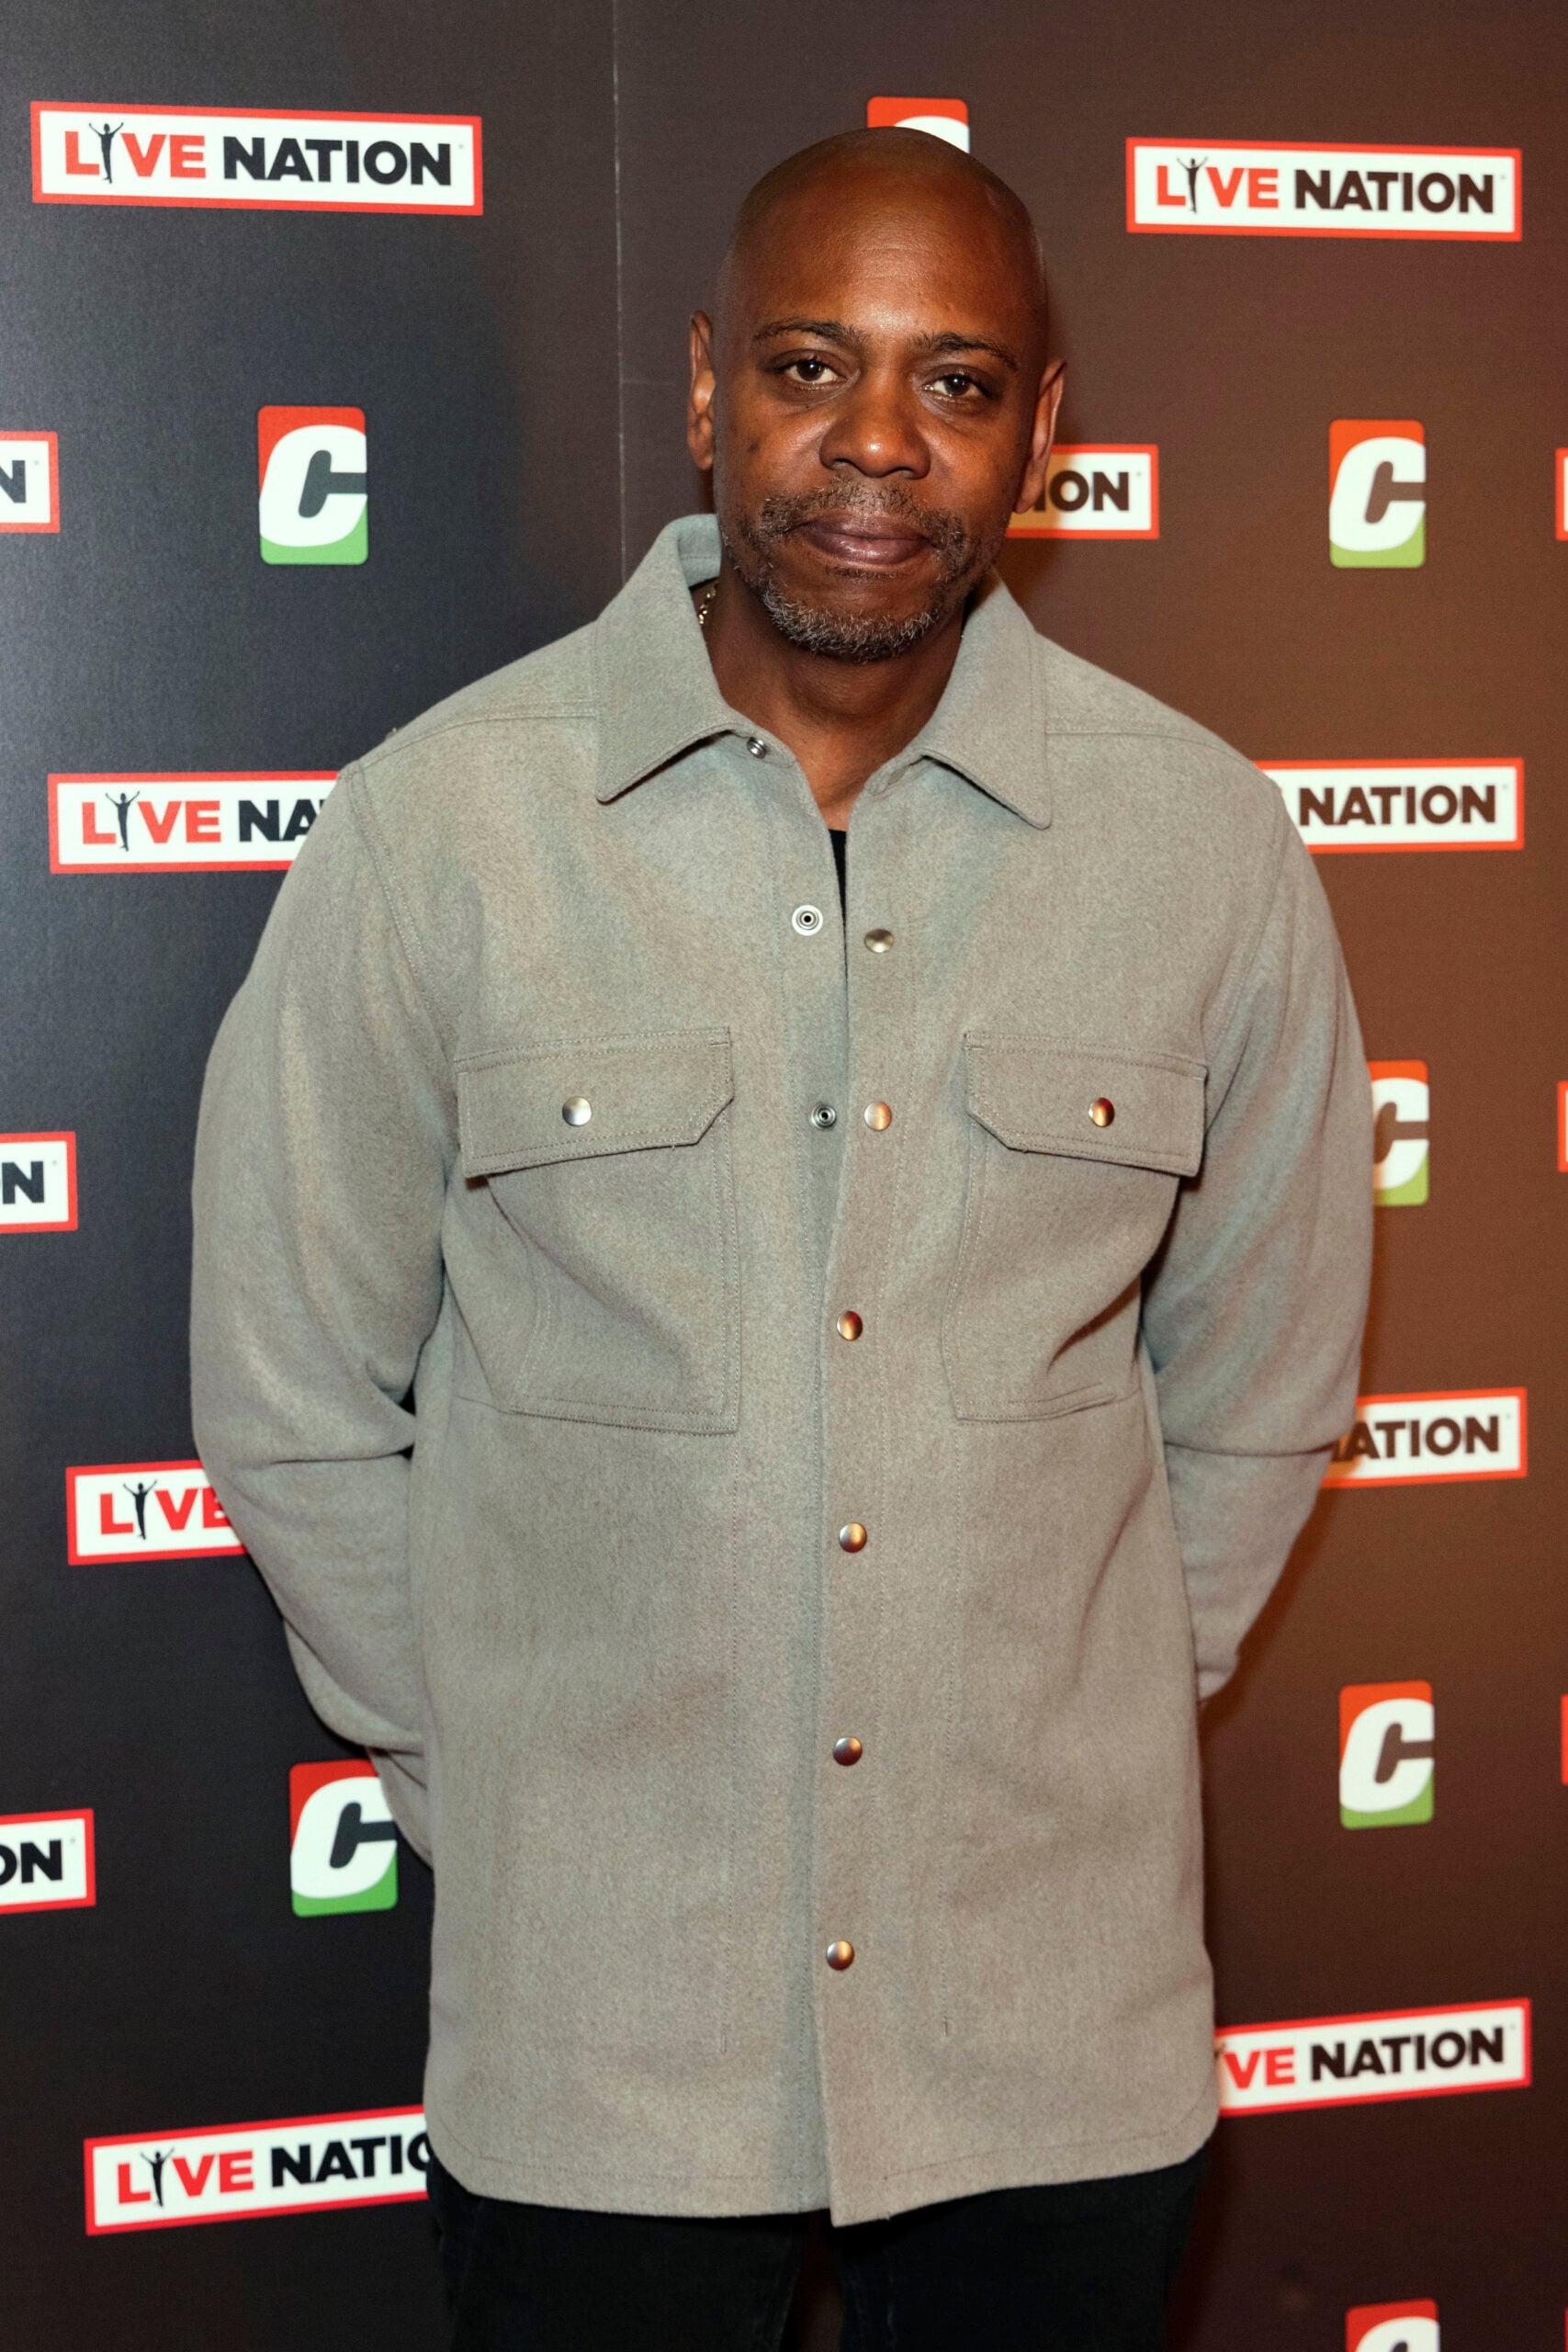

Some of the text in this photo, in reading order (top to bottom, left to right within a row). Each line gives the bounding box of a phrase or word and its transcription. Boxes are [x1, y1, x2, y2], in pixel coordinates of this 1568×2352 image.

[64, 121, 452, 186] LIVE NATION
[1156, 157, 1495, 214] LIVE NATION
[258, 424, 367, 548] C
[1329, 436, 1427, 552] C
[81, 791, 326, 853] LIVE NA
[1298, 785, 1496, 827] NATION
[1339, 1698, 1435, 1813] C
[290, 1776, 398, 1899] C
[1311, 2027, 1505, 2082] NATION
[117, 2147, 255, 2208] LIVE
